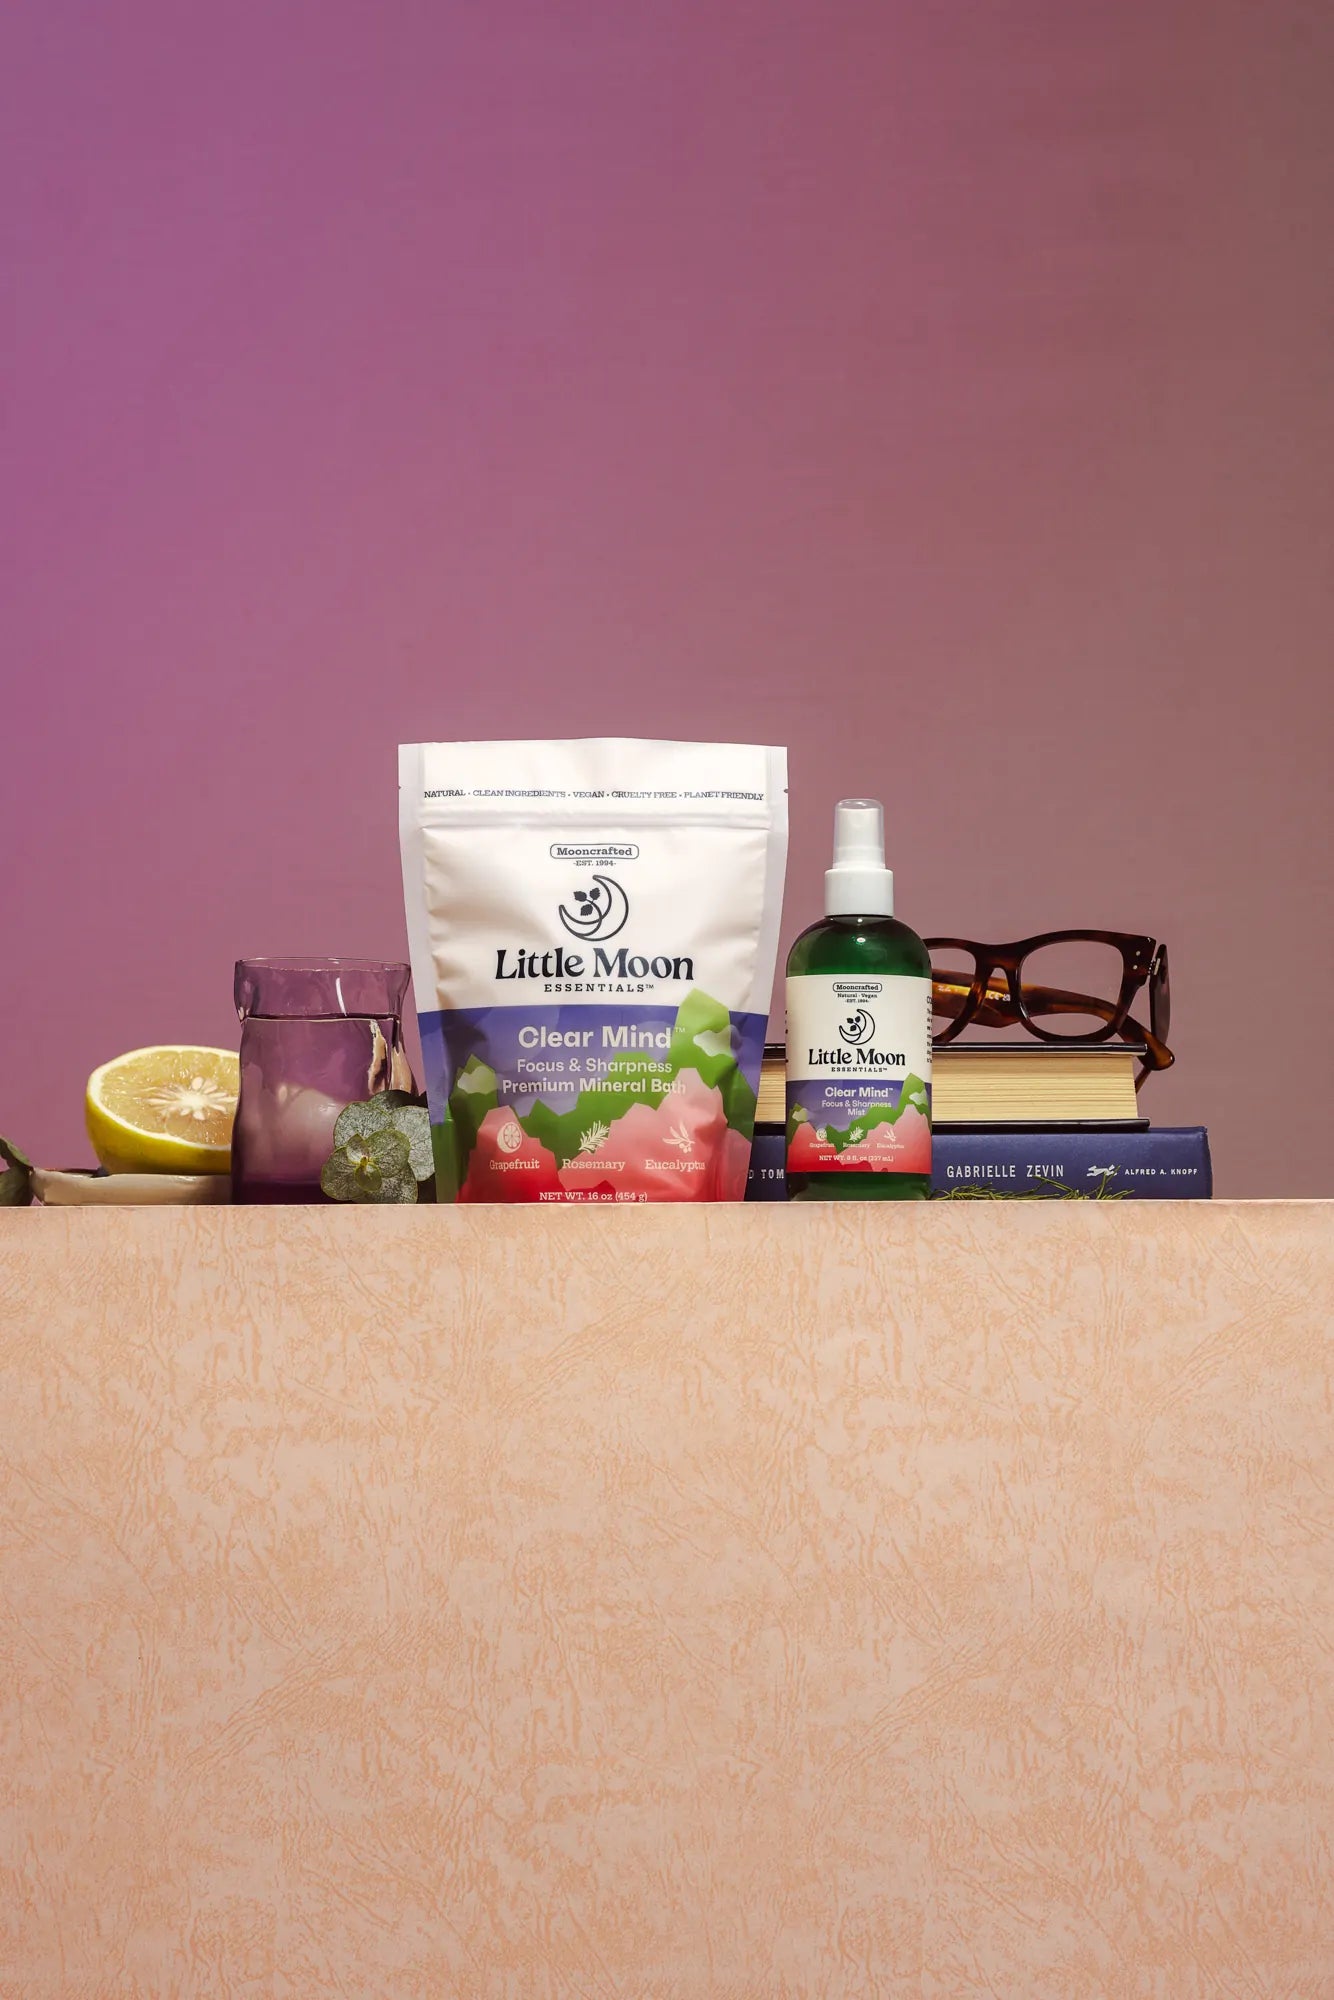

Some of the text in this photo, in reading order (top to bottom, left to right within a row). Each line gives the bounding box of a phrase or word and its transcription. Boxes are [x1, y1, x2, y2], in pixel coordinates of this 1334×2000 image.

[424, 789, 466, 798] NATURAL
[472, 789, 505, 797] CLEAN
[505, 789, 566, 798] INGREDIENTS
[611, 791, 652, 799] CRUELTY
[654, 791, 677, 799] FREE
[684, 791, 719, 799] PLANET
[721, 791, 764, 801] FRIENDLY
[556, 846, 632, 856] Mooncrafted
[495, 947, 694, 980] Little Moon
[518, 1025, 594, 1049] Clear
[808, 1048, 906, 1066] Little Moon
[517, 1058, 672, 1075] Focus & Sharpness
[502, 1077, 686, 1094] Premium Mineral Bath
[825, 1087, 857, 1098] Clear
[821, 1100, 892, 1108] Focus & Sharpness
[847, 1108, 866, 1116] Mist
[489, 1158, 540, 1172] Grapefruit
[562, 1158, 626, 1172] Rosemary
[946, 1164, 1064, 1178] GABRIELLE ZEVIN
[1124, 1168, 1198, 1176] ALFRED A. KNOPF
[539, 1192, 563, 1200] NET
[565, 1192, 585, 1200] WT.
[587, 1192, 599, 1200] 16
[615, 1192, 637, 1201] (454
[638, 1192, 648, 1202] g)
